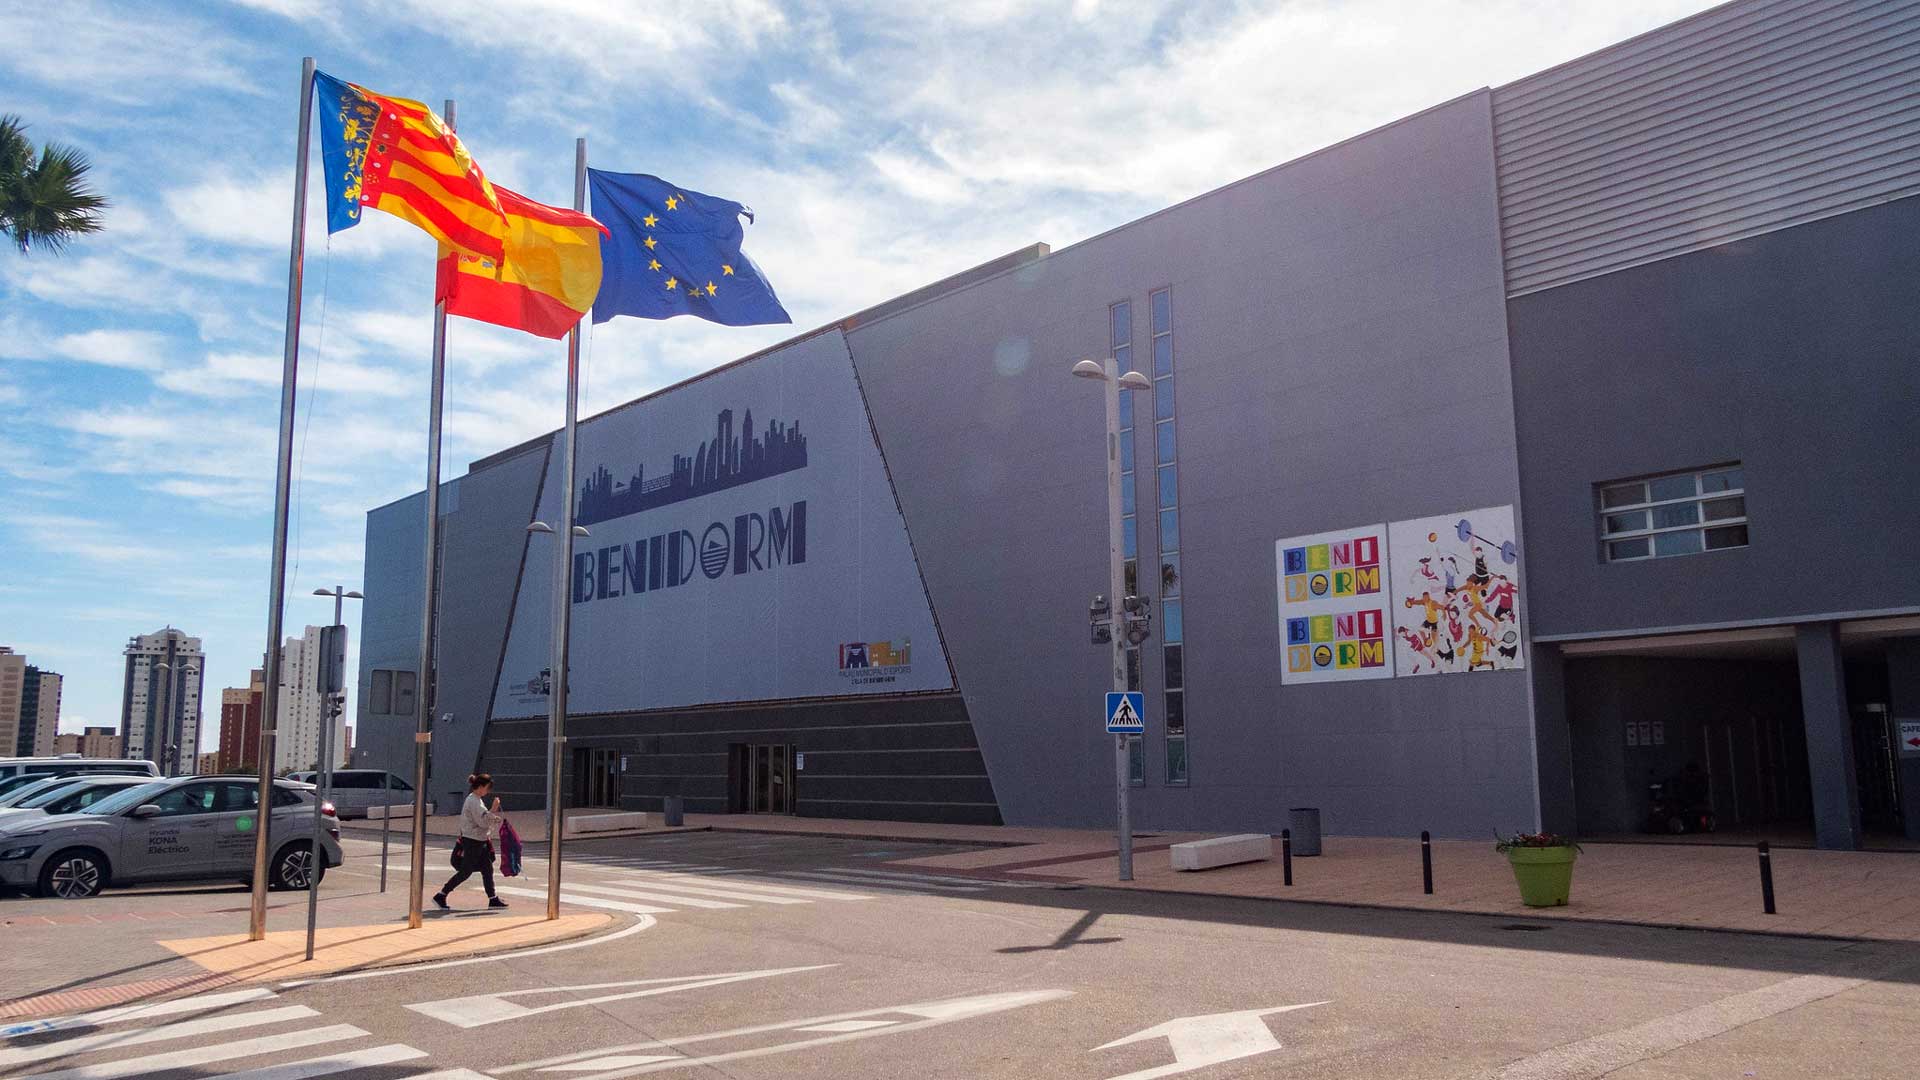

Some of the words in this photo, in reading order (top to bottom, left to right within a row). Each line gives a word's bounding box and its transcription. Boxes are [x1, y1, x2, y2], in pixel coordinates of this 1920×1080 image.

[573, 500, 807, 604] BENIDORM
[1285, 538, 1377, 574] BENI
[1286, 566, 1380, 600] DORM
[1288, 611, 1380, 644] BENI
[1290, 640, 1384, 671] DORM
[148, 845, 190, 855] Eléctrico
[149, 837, 178, 845] KONA
